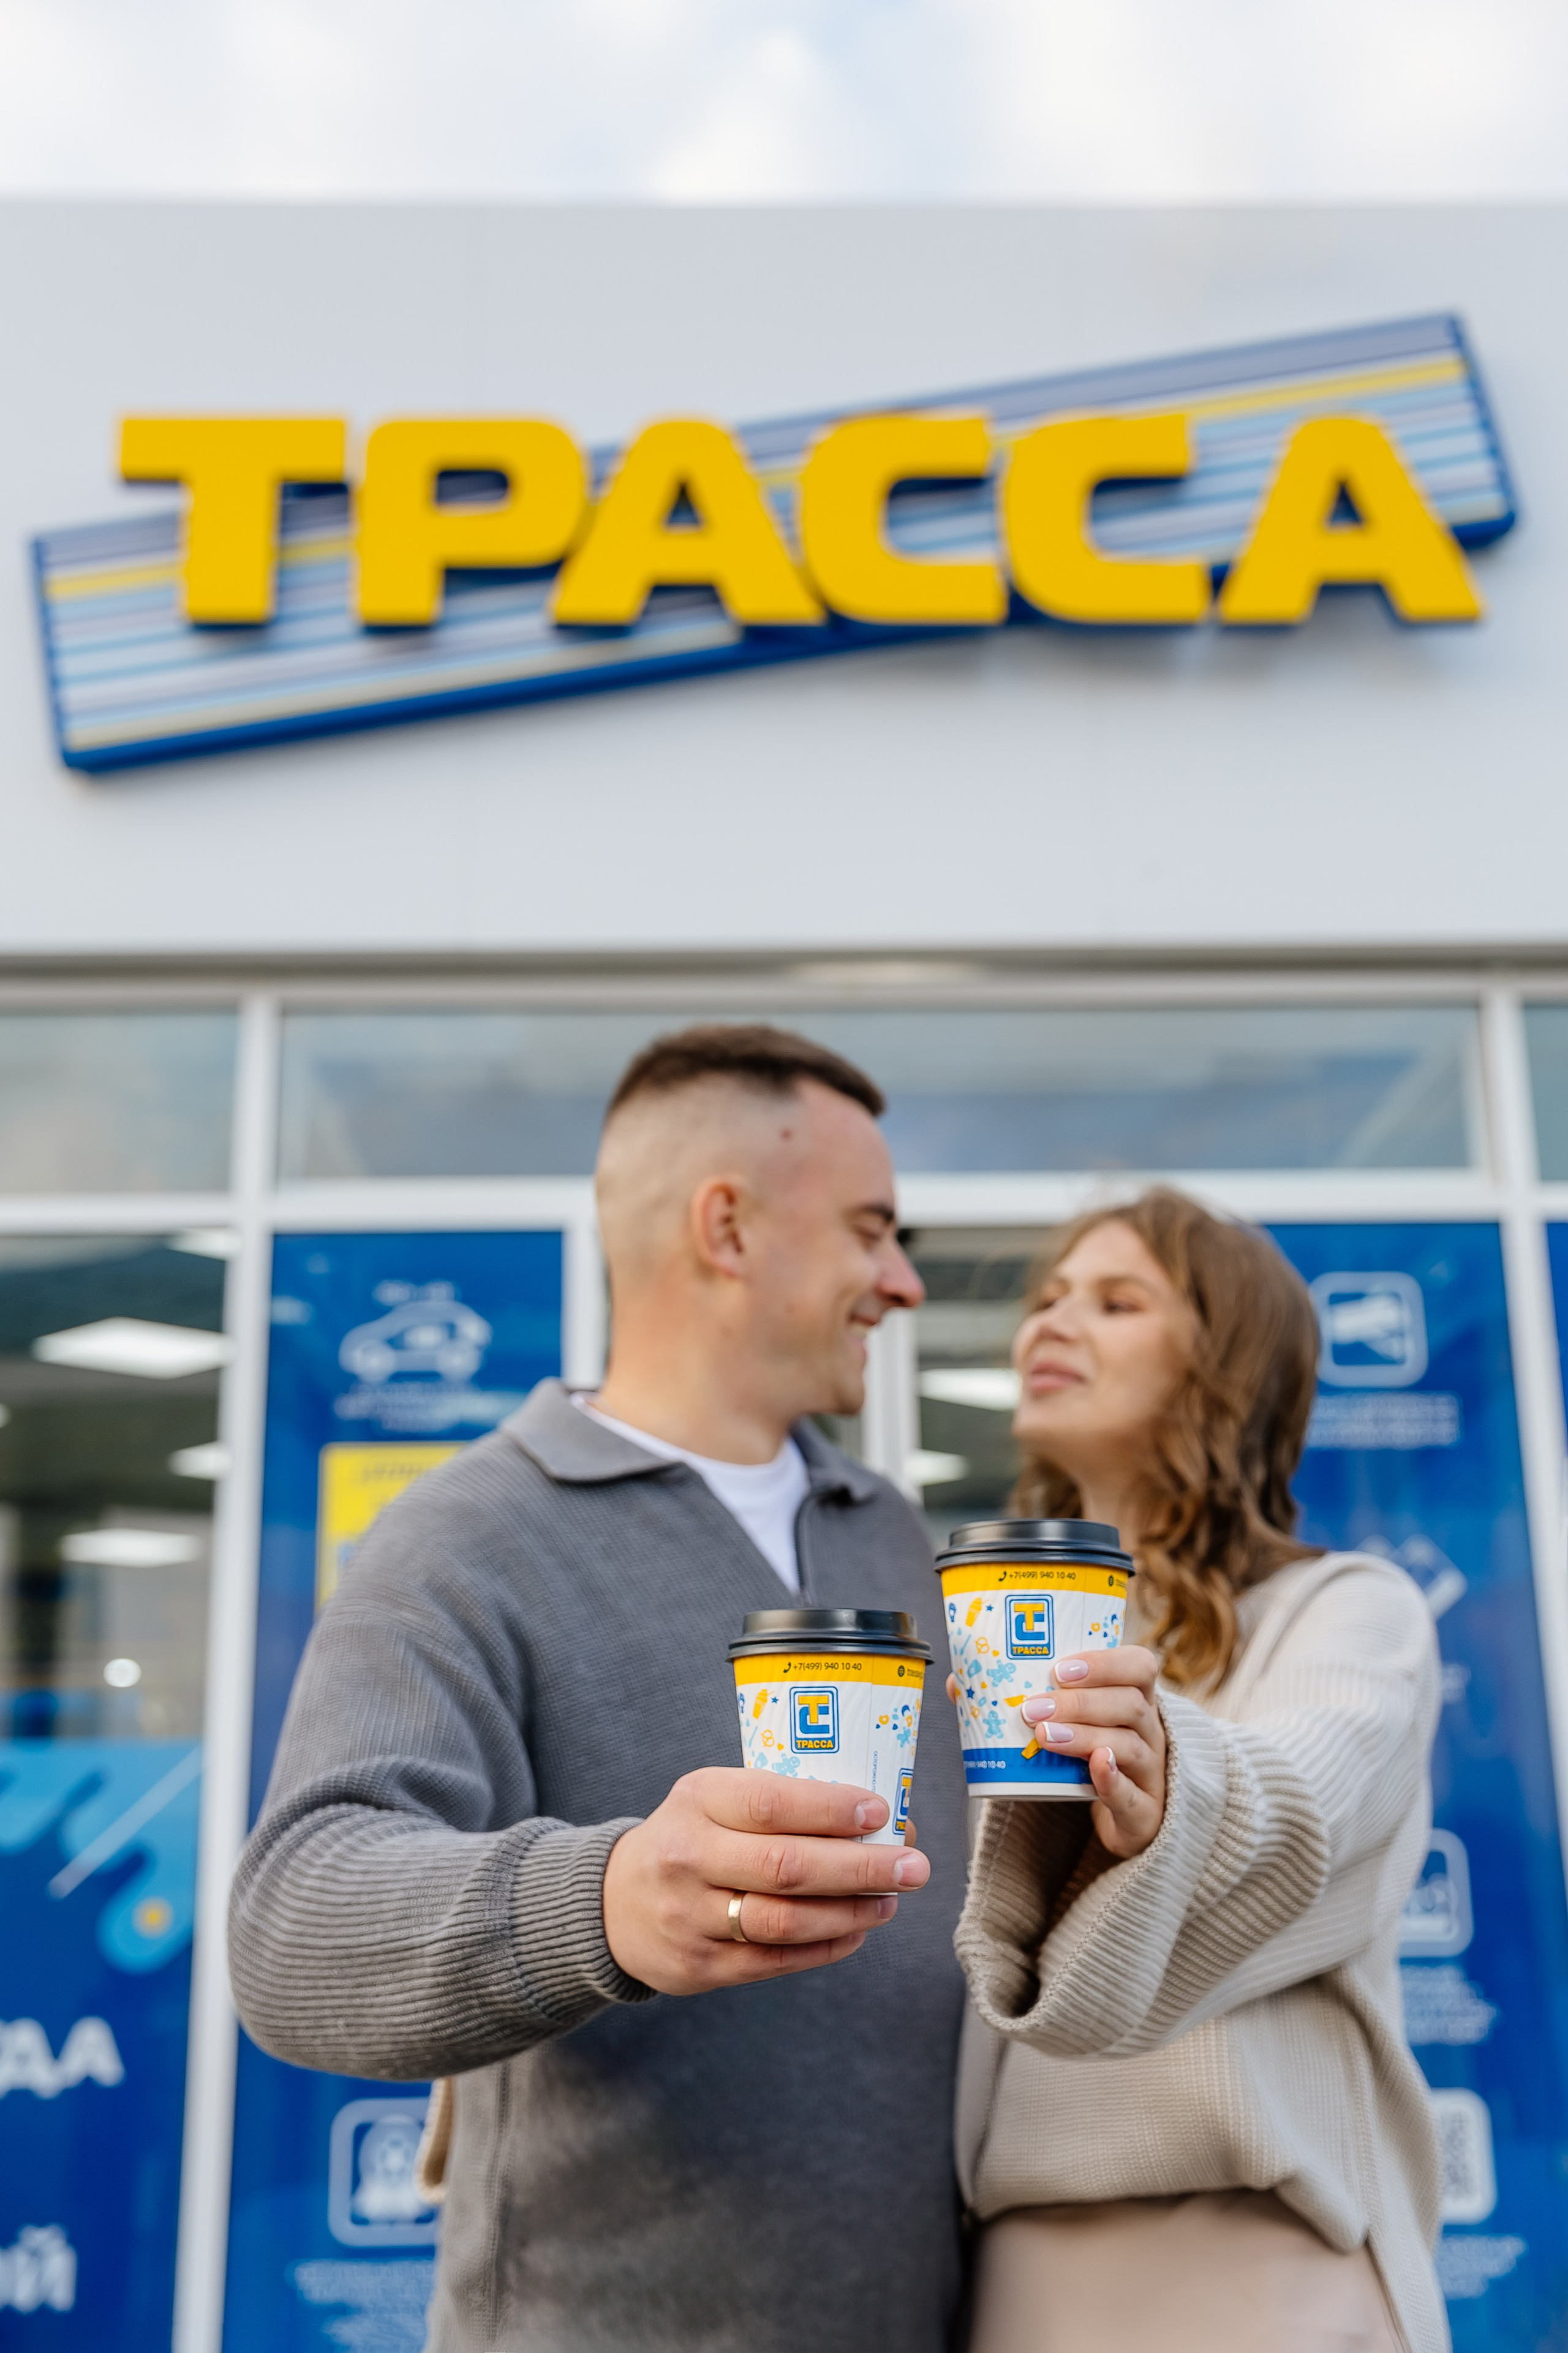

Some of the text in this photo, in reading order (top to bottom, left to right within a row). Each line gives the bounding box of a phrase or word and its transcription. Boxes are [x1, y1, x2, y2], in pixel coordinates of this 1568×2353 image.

[119, 412, 1481, 626] ТРАССА
[1012, 1646, 1049, 1655] ТРАССА
[793, 1662, 822, 1671] +7(499)
[796, 1740, 834, 1748] ТРАССА
